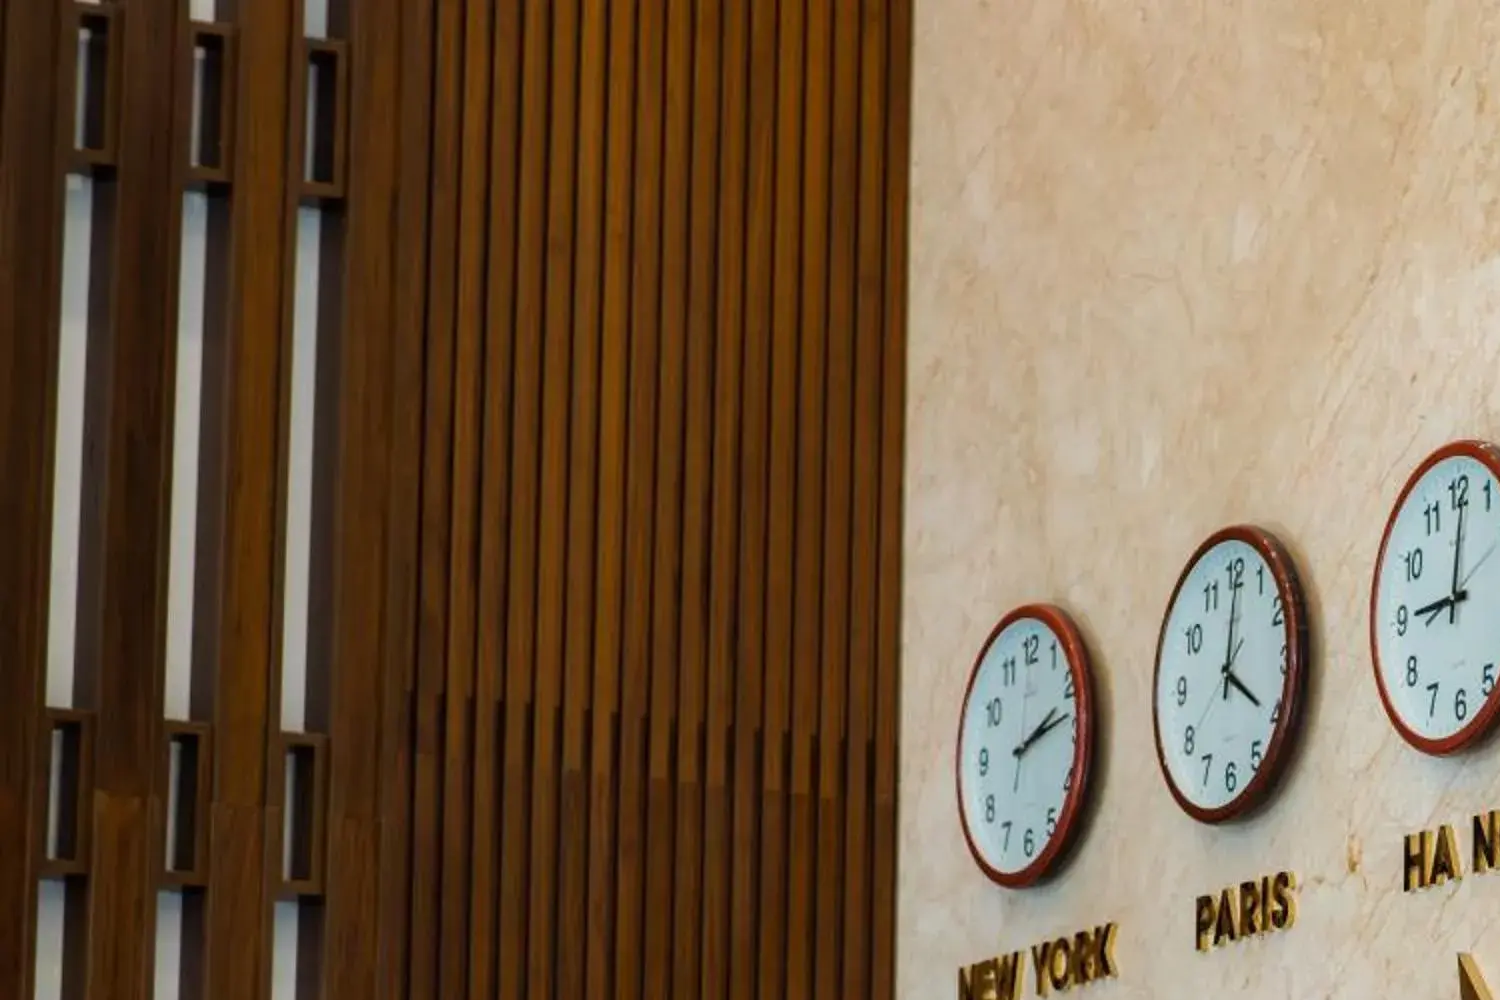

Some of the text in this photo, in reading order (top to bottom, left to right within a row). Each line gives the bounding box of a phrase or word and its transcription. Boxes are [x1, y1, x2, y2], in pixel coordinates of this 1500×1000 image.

[1448, 474, 1469, 509] 12
[1483, 479, 1491, 511] 1
[1424, 500, 1441, 536] 11
[1225, 557, 1245, 590] 12
[1256, 565, 1264, 595] 1
[1404, 548, 1423, 581] 10
[1203, 579, 1219, 612] 11
[1271, 594, 1283, 626] 2
[1397, 604, 1408, 636] 9
[1022, 634, 1039, 667] 12
[1050, 641, 1057, 670] 1
[1185, 624, 1202, 655] 10
[1003, 656, 1016, 686] 11
[1064, 670, 1074, 699] 2
[1406, 655, 1418, 687] 8
[1482, 664, 1495, 697] 5
[1177, 676, 1187, 706] 9
[1427, 683, 1439, 717] 7
[1455, 688, 1467, 720] 6
[986, 697, 1002, 727] 10
[1184, 725, 1195, 755] 8
[1251, 741, 1262, 771] 5
[979, 748, 989, 776] 9
[1201, 754, 1212, 786] 7
[1225, 762, 1236, 792] 6
[985, 795, 995, 823] 8
[1046, 808, 1057, 837] 5
[1001, 821, 1012, 852] 7
[1023, 828, 1034, 857] 6
[1403, 825, 1462, 892] HA
[1195, 870, 1299, 951] PARIS
[1031, 922, 1119, 997] YORK
